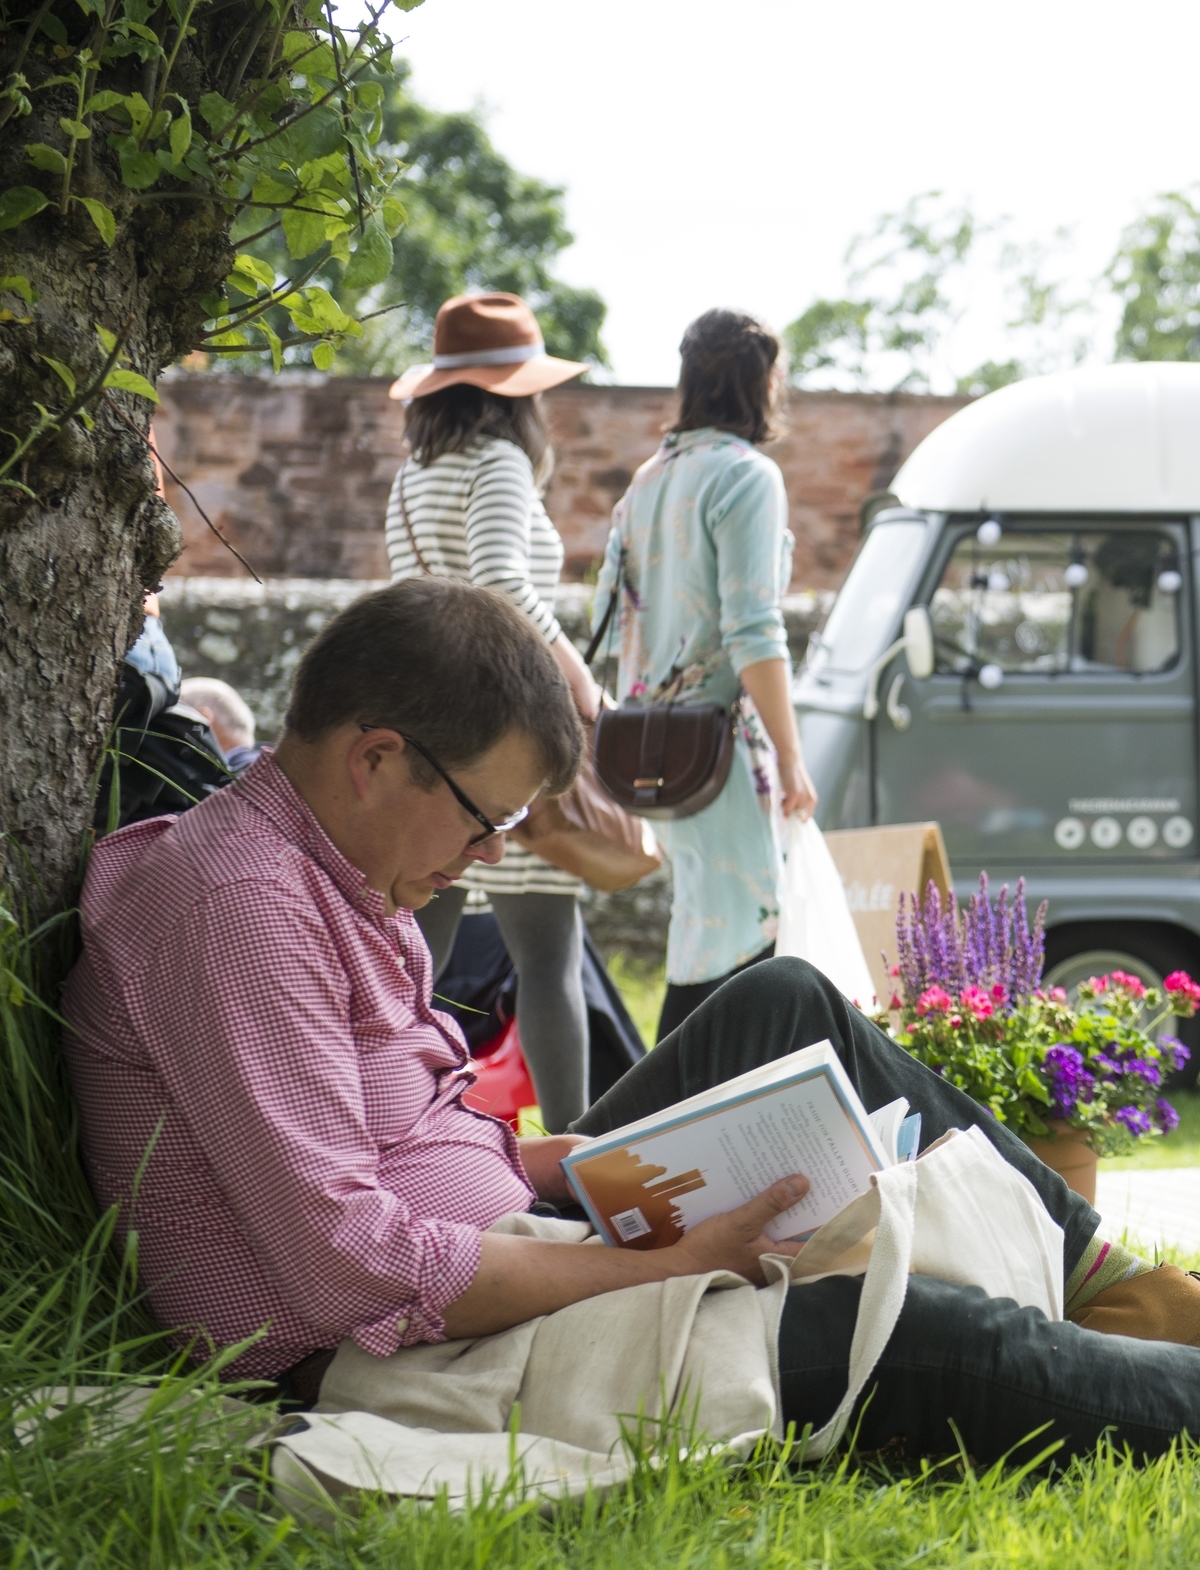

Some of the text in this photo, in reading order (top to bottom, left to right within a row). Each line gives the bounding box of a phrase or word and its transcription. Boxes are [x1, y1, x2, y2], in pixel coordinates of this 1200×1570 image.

[805, 1100, 821, 1122] PRAISE
[818, 1123, 829, 1137] FOR
[825, 1136, 846, 1167] FALLEN
[841, 1167, 860, 1194] GLORY
